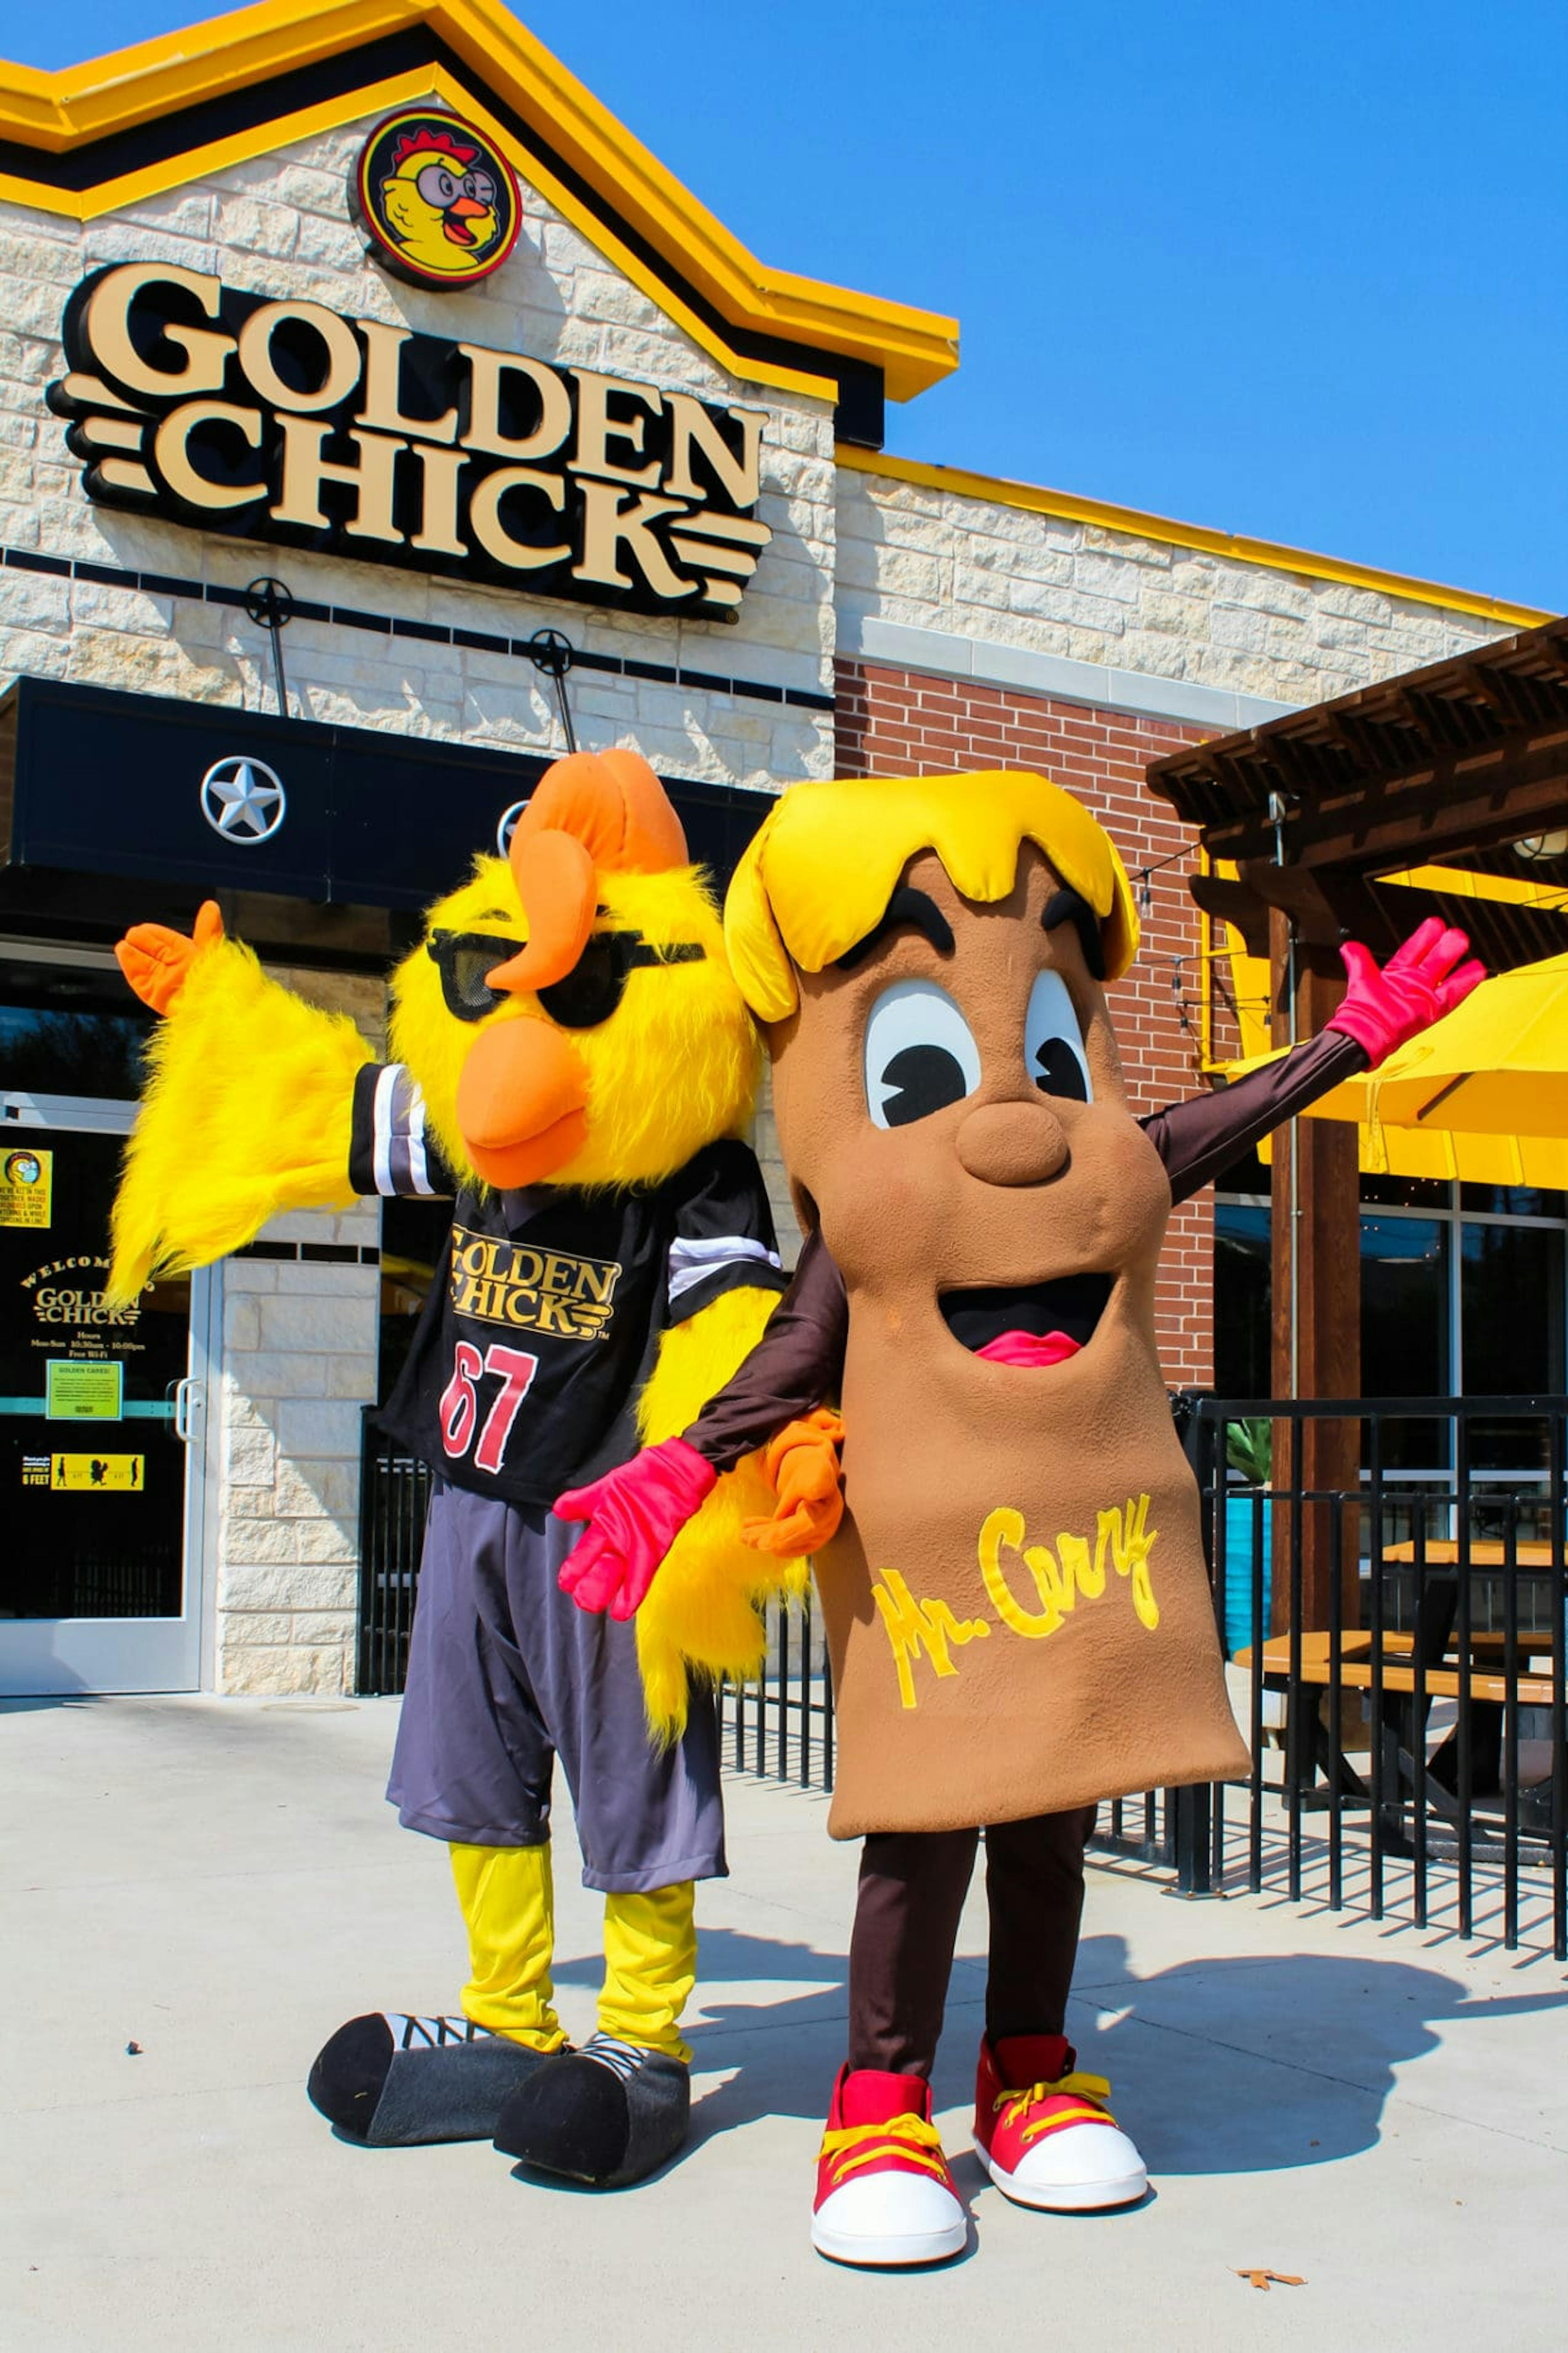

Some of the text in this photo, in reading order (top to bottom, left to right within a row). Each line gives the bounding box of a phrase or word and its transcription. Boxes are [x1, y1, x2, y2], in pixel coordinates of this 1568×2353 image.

[86, 262, 770, 509] GOLDEN
[154, 400, 698, 599] CHICK
[20, 1256, 111, 1288] WELCOM
[36, 1288, 139, 1309] GOLD
[46, 1306, 127, 1325] CHICK
[439, 1341, 539, 1475] 67
[22, 1474, 49, 1485] 6 FEET
[871, 1568, 991, 1708] Mr.
